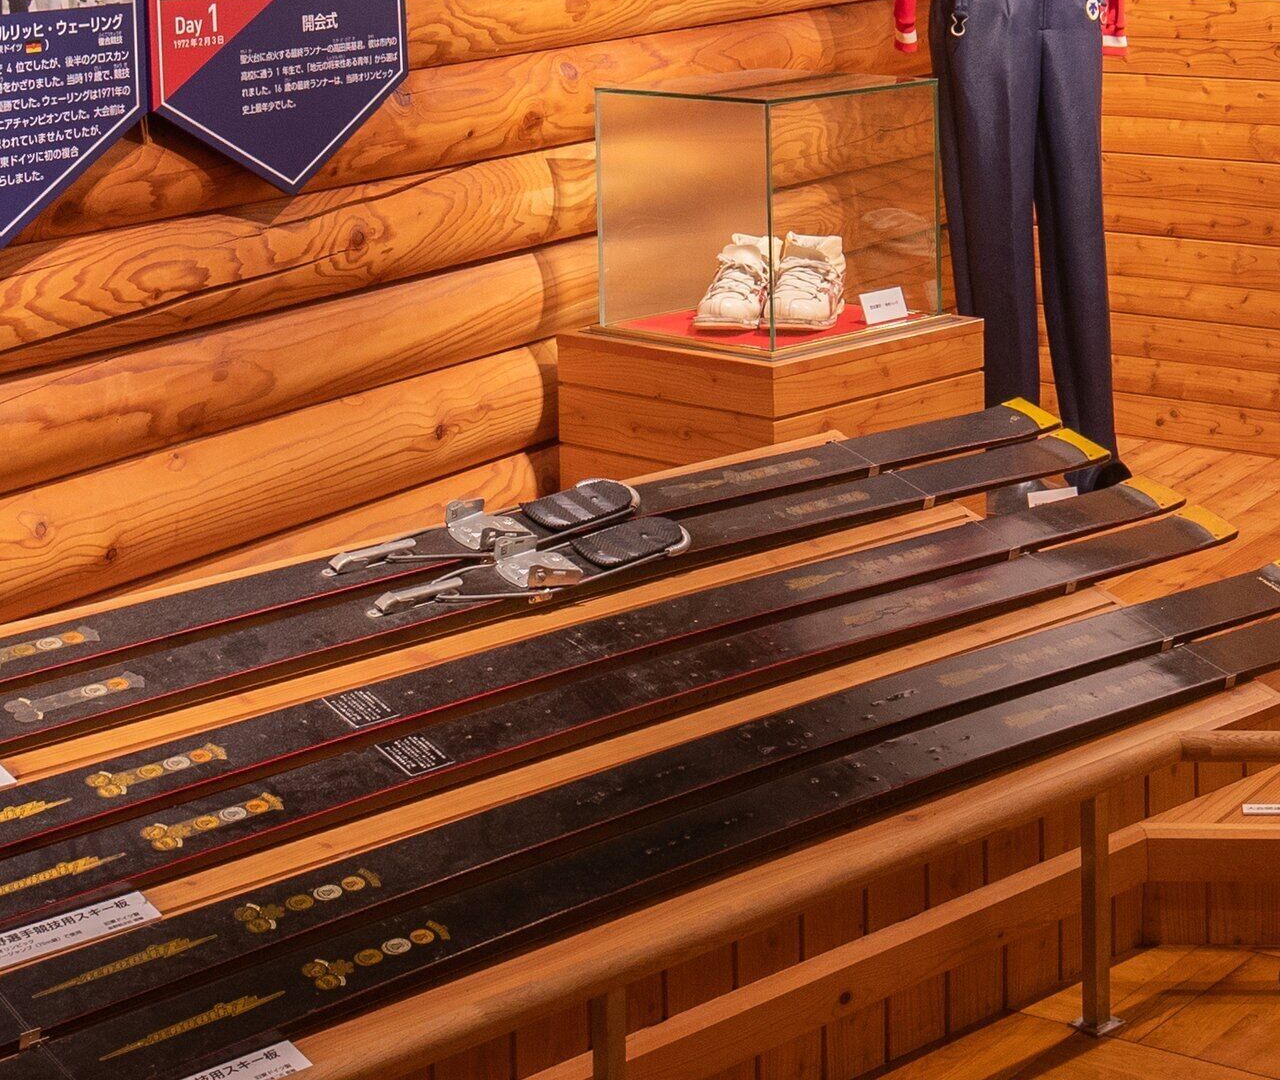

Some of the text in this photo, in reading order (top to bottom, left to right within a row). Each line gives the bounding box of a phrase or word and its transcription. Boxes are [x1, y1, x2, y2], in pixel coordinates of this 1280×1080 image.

[175, 3, 218, 36] Day 1
[302, 11, 339, 33] 開会式
